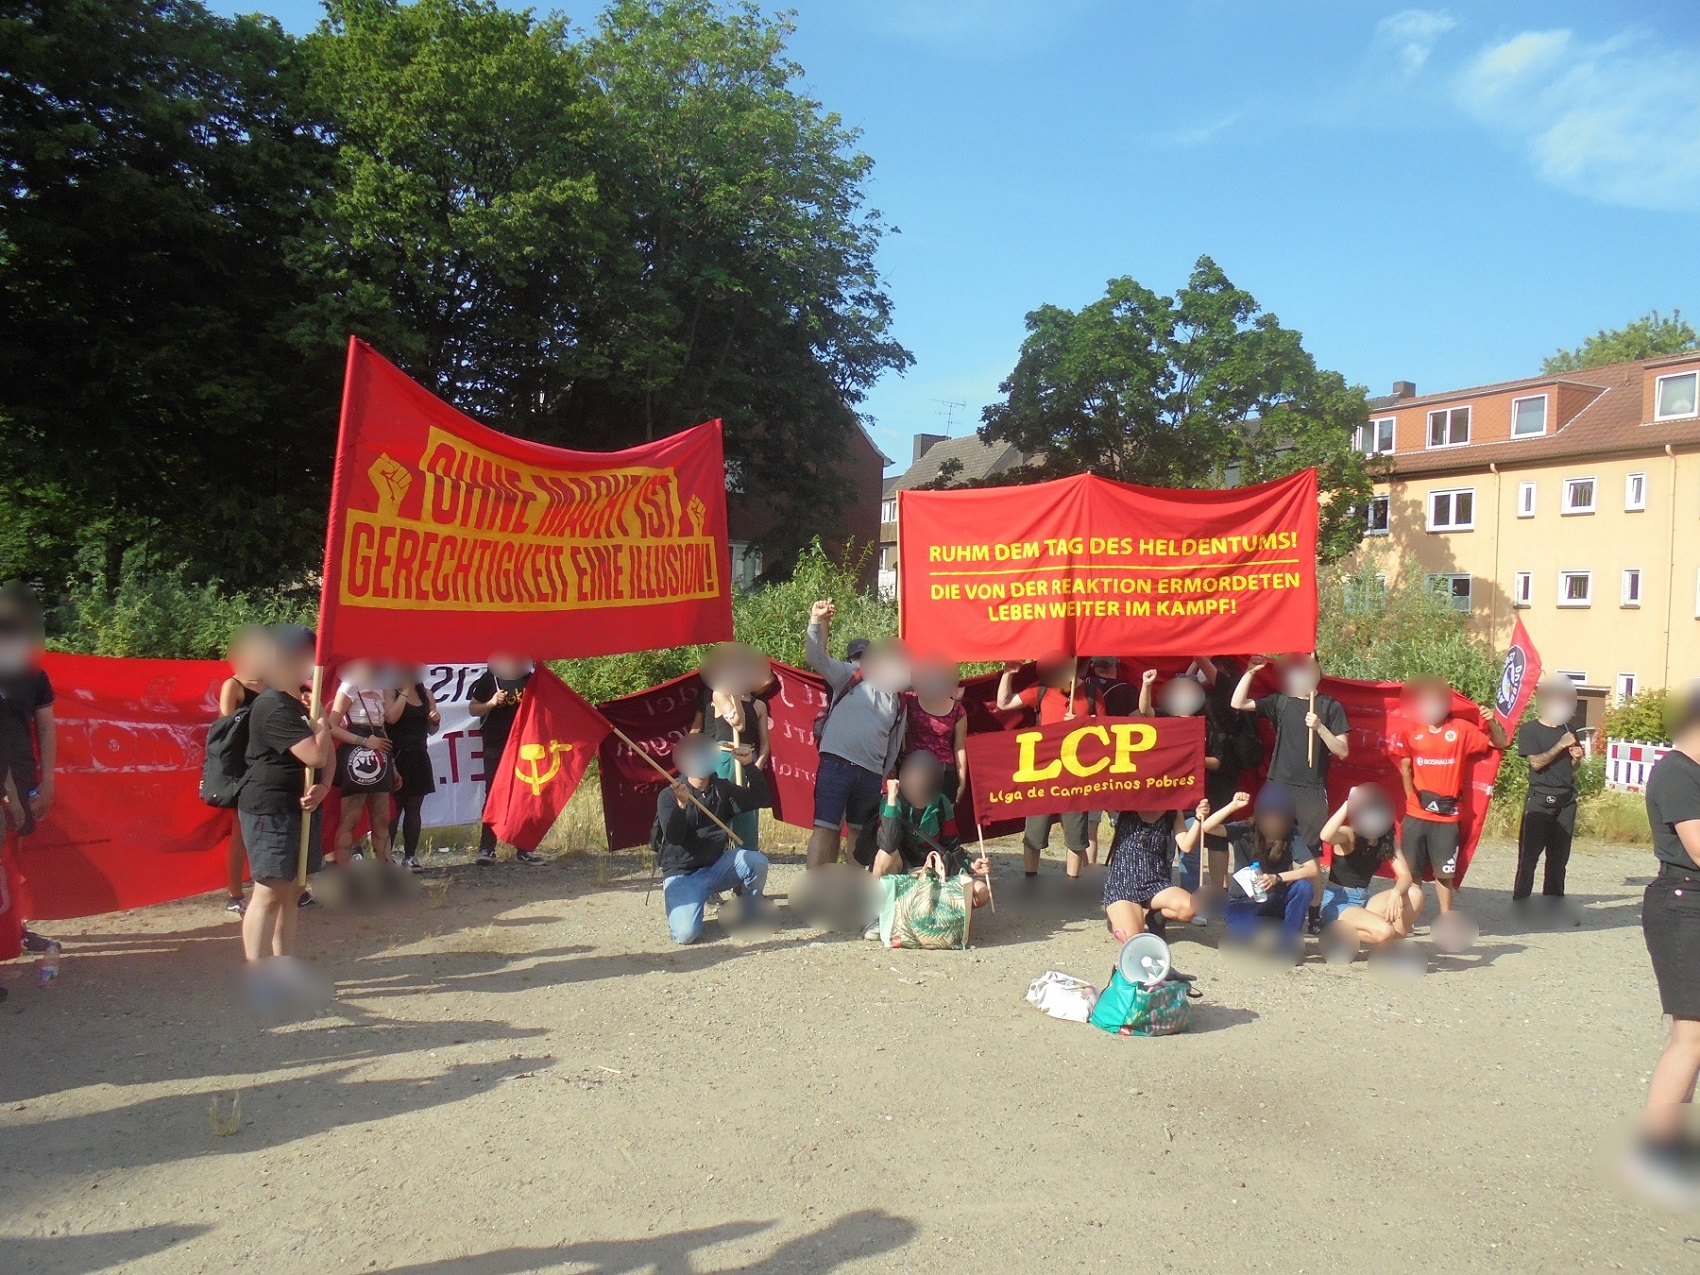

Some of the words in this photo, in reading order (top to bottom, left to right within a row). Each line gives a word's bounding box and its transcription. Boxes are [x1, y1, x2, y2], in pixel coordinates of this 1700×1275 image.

[427, 442, 537, 534] OHNE
[530, 474, 637, 539] MACHT
[634, 474, 676, 538] IST
[347, 521, 568, 603] GERECHTIGKEIT
[570, 544, 624, 602] EINE
[629, 543, 715, 600] ILLUSION!
[929, 545, 990, 562] RUHM
[994, 541, 1040, 561] DEM
[1043, 537, 1084, 556] TAG
[1089, 537, 1133, 556] DES
[1139, 531, 1297, 556] HELDENTUMS!
[930, 584, 961, 600] DIE
[964, 582, 1006, 600] VON
[1010, 580, 1048, 598] DER
[1051, 577, 1152, 595] REAKTION
[1157, 572, 1300, 594] ERMORDETEN
[988, 603, 1046, 622] LEBEN
[1049, 600, 1120, 619] WEITER
[1125, 600, 1150, 617] IM
[1156, 598, 1237, 616] KAMPF!
[1012, 723, 1157, 783] LCP
[990, 791, 1023, 804] Liga
[1027, 786, 1045, 798] de
[1050, 778, 1141, 797] Campesinos
[1146, 774, 1196, 789] Pobres
